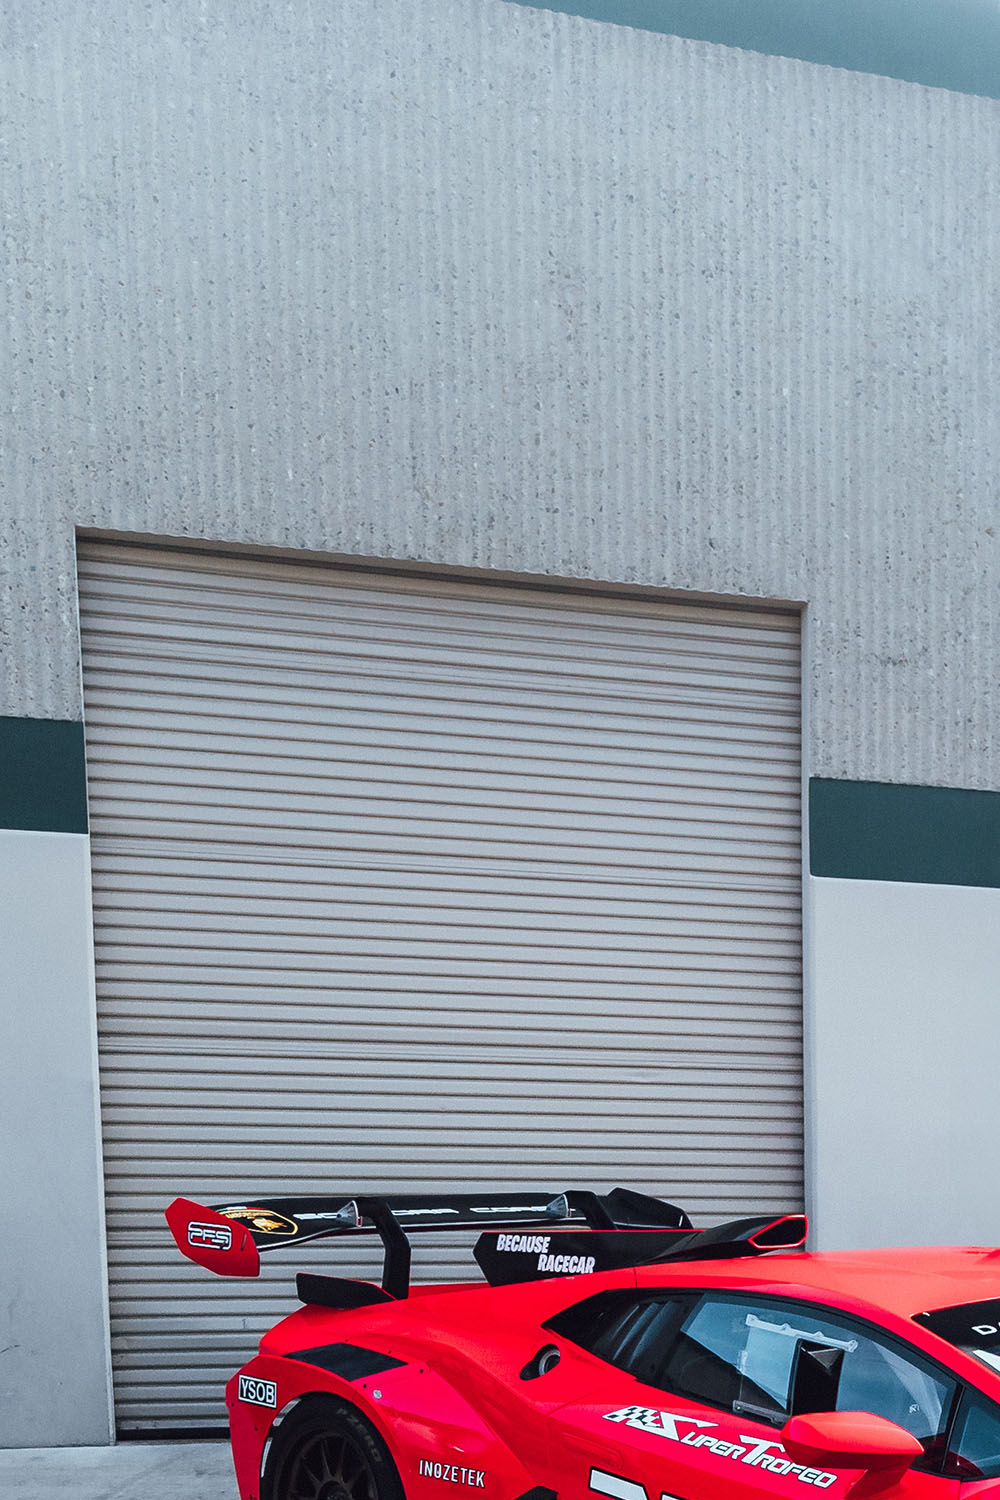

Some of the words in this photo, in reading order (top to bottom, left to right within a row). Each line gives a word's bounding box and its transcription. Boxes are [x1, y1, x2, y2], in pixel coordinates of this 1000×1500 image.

[496, 1234, 551, 1254] BECAUSE
[537, 1254, 596, 1274] RACECAR
[241, 1378, 275, 1404] YSOB
[418, 1459, 485, 1488] INOZETEK
